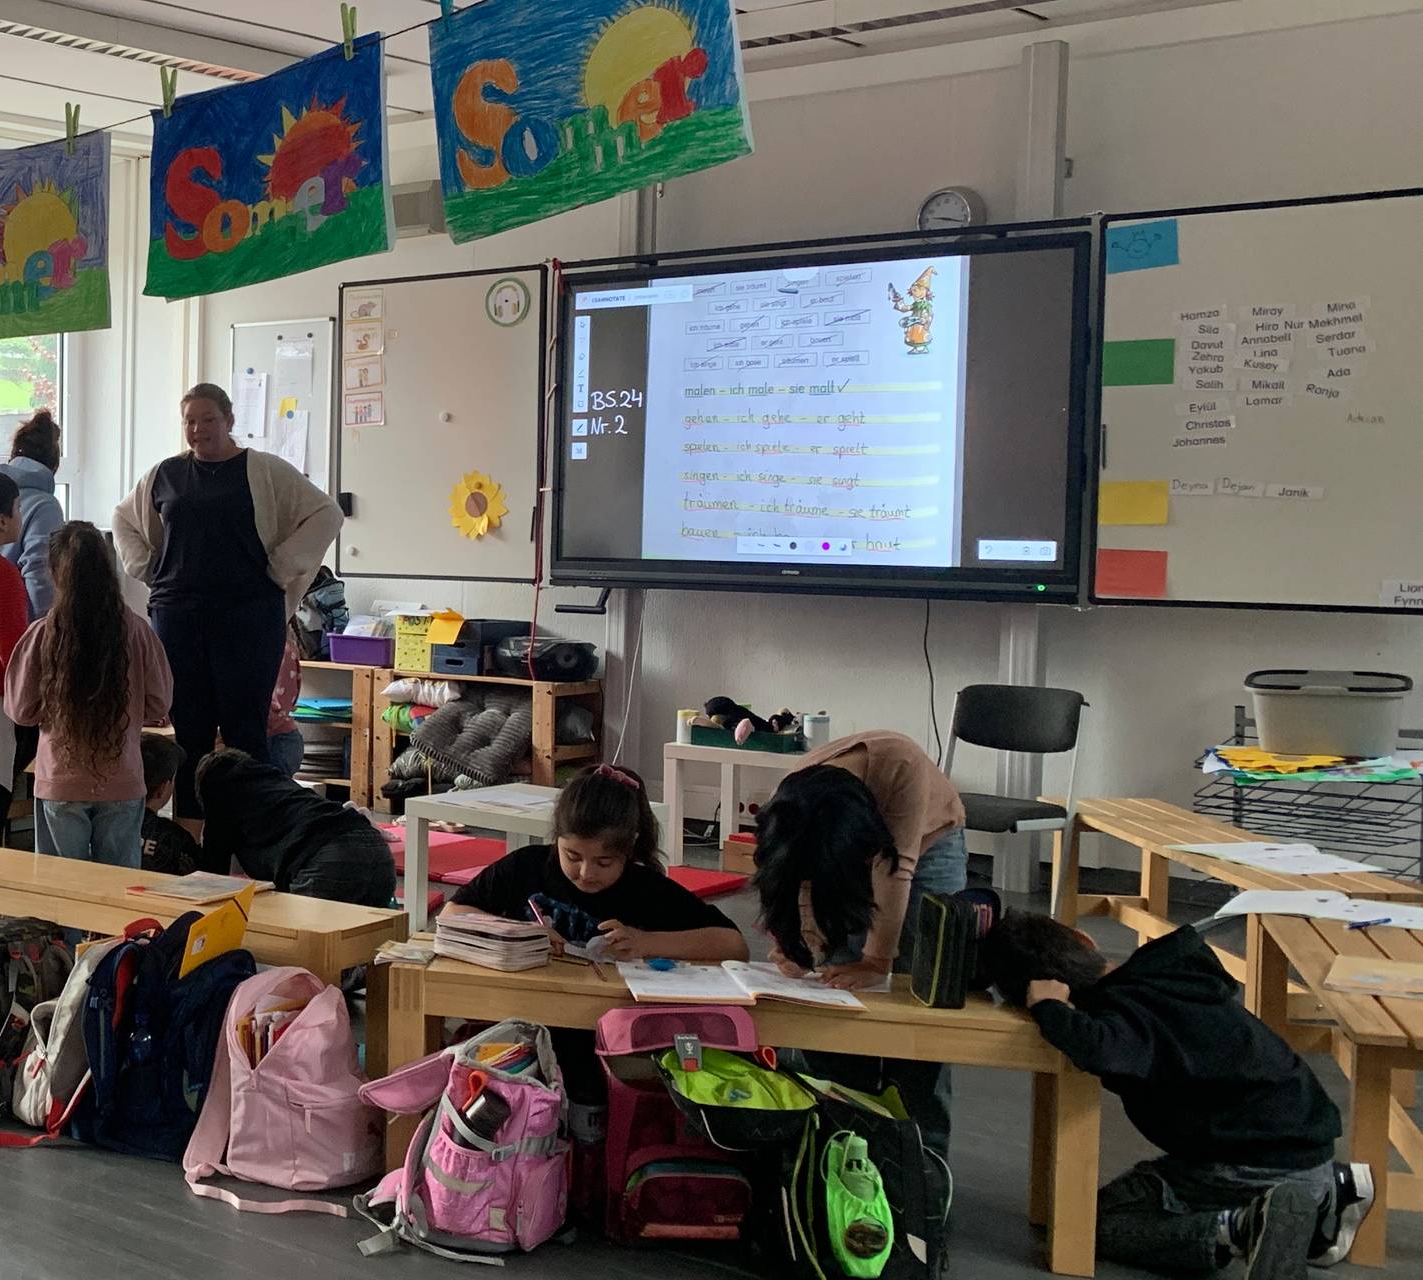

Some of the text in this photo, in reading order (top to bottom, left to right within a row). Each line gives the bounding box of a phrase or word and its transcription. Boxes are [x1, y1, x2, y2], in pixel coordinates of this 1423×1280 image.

[1252, 307, 1283, 317] Miray
[1327, 302, 1356, 313] Mina
[1180, 310, 1220, 321] Hamza
[1284, 320, 1304, 330] Nur
[1315, 330, 1356, 344] Serdar
[1191, 340, 1224, 350] Davut
[1328, 345, 1366, 357] Tuana
[1327, 368, 1351, 379] Ada
[685, 380, 834, 395] malen ich male sie malt
[591, 389, 643, 410] BS.24
[1245, 397, 1283, 406] Lamar
[591, 415, 628, 434] Nr. 2
[737, 408, 755, 423] ich
[838, 410, 865, 431] geht
[1185, 419, 1231, 431] Christos
[1172, 436, 1226, 448] Johannes
[682, 471, 719, 485] singen
[1278, 487, 1310, 498] Janik
[866, 532, 901, 551] baut
